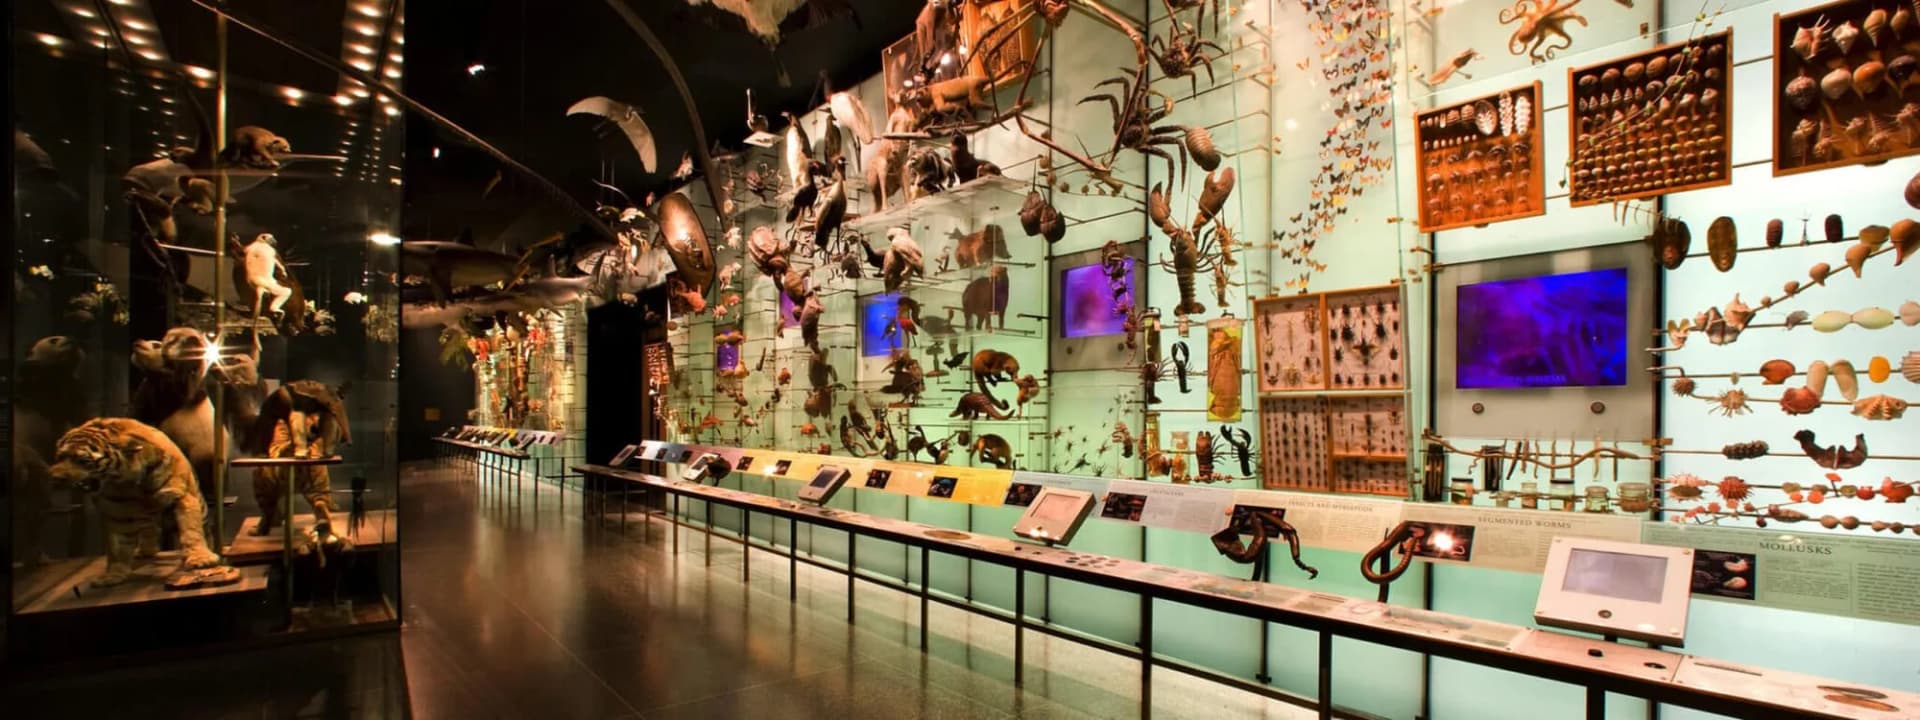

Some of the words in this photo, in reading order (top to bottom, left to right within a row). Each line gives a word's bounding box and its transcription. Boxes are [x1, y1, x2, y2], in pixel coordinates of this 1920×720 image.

[1478, 516, 1532, 526] SEGMENTED
[1535, 520, 1572, 529] WORMS
[1760, 543, 1833, 555] MOLLUSKS
